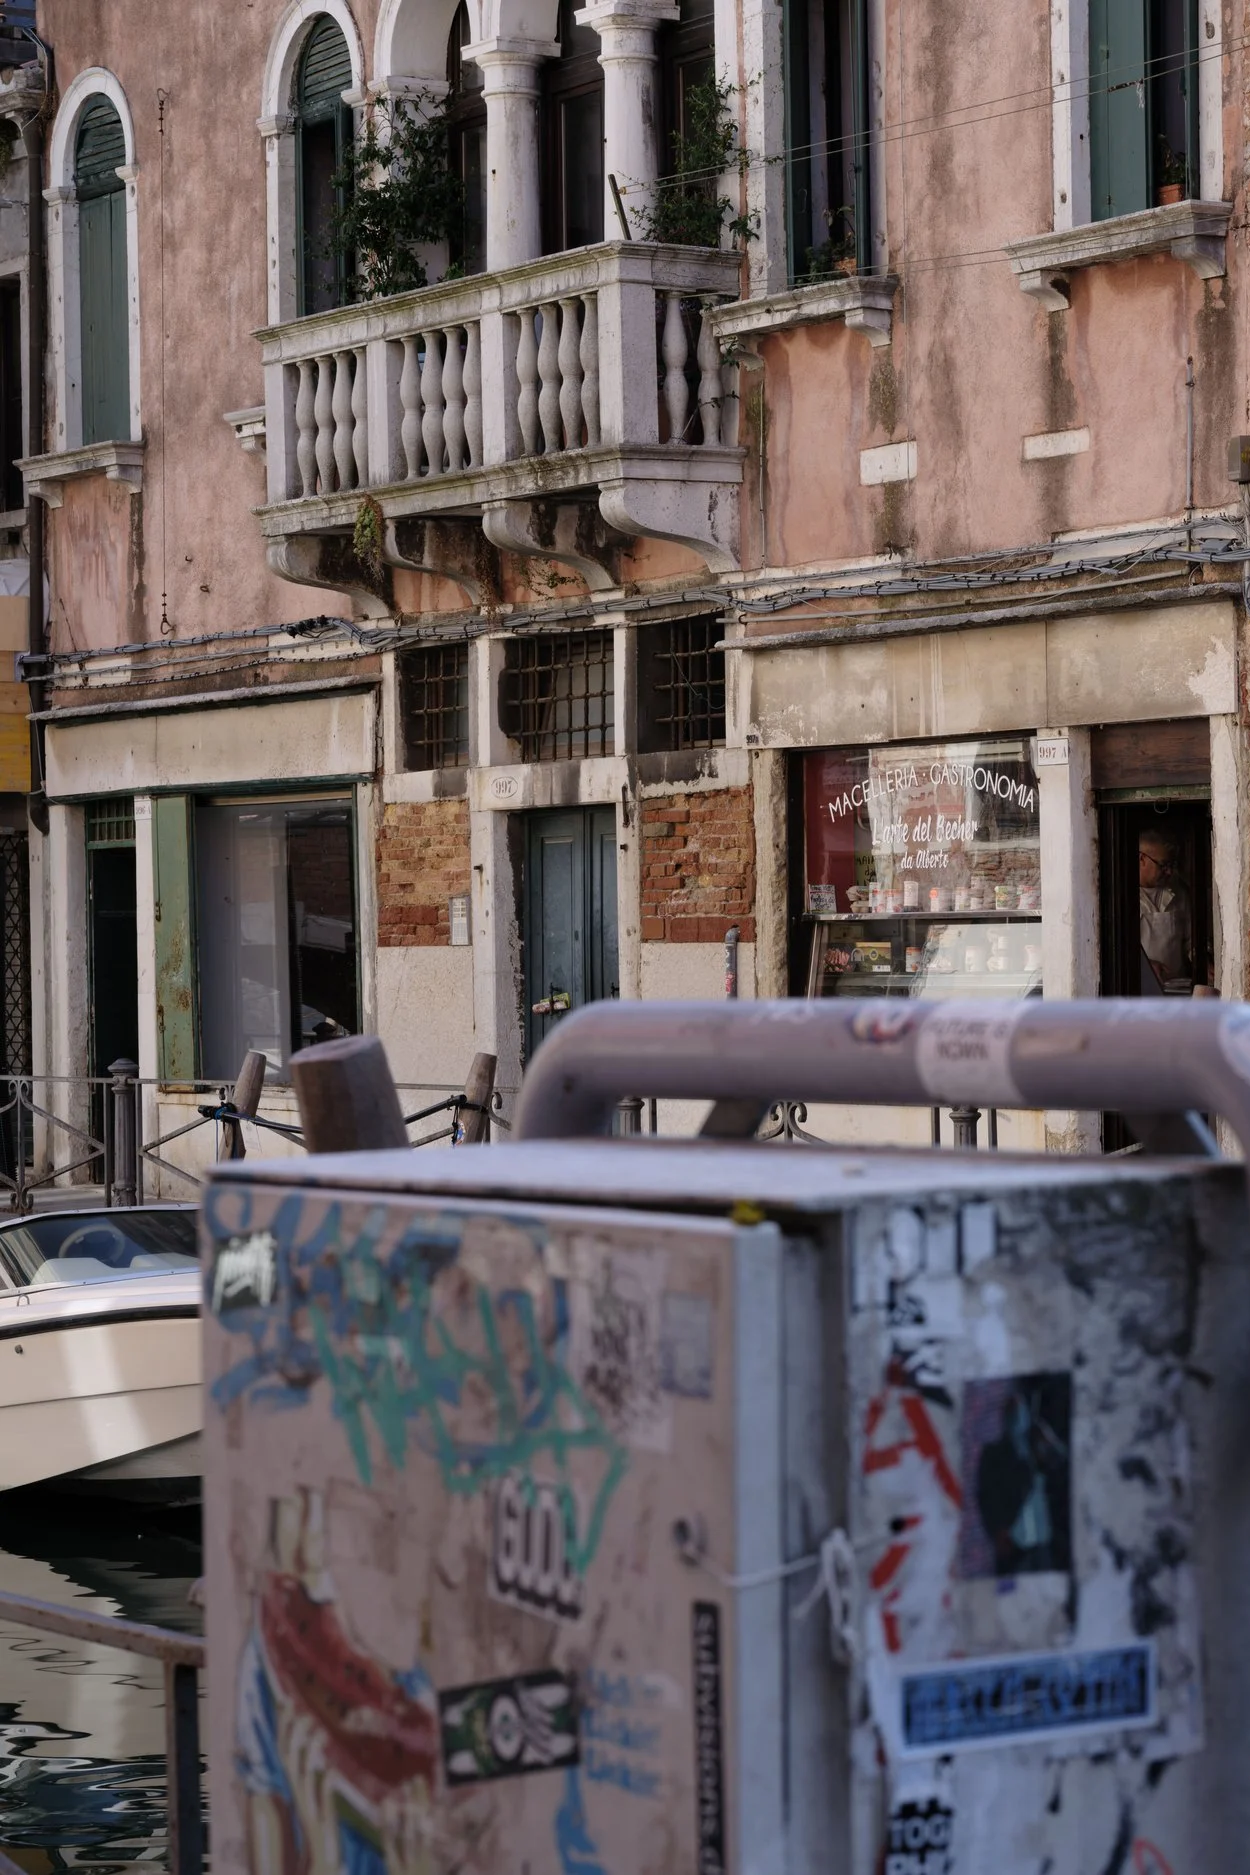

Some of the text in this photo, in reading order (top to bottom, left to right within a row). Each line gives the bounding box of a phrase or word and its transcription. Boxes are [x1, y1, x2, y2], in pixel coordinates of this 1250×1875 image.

[1039, 746, 1057, 758] 997
[495, 780, 512, 794] 997
[828, 763, 1035, 823] MACELLERIA GASTRONOMIA
[871, 814, 978, 846] L'arte del Becher
[900, 849, 949, 869] da Alberto
